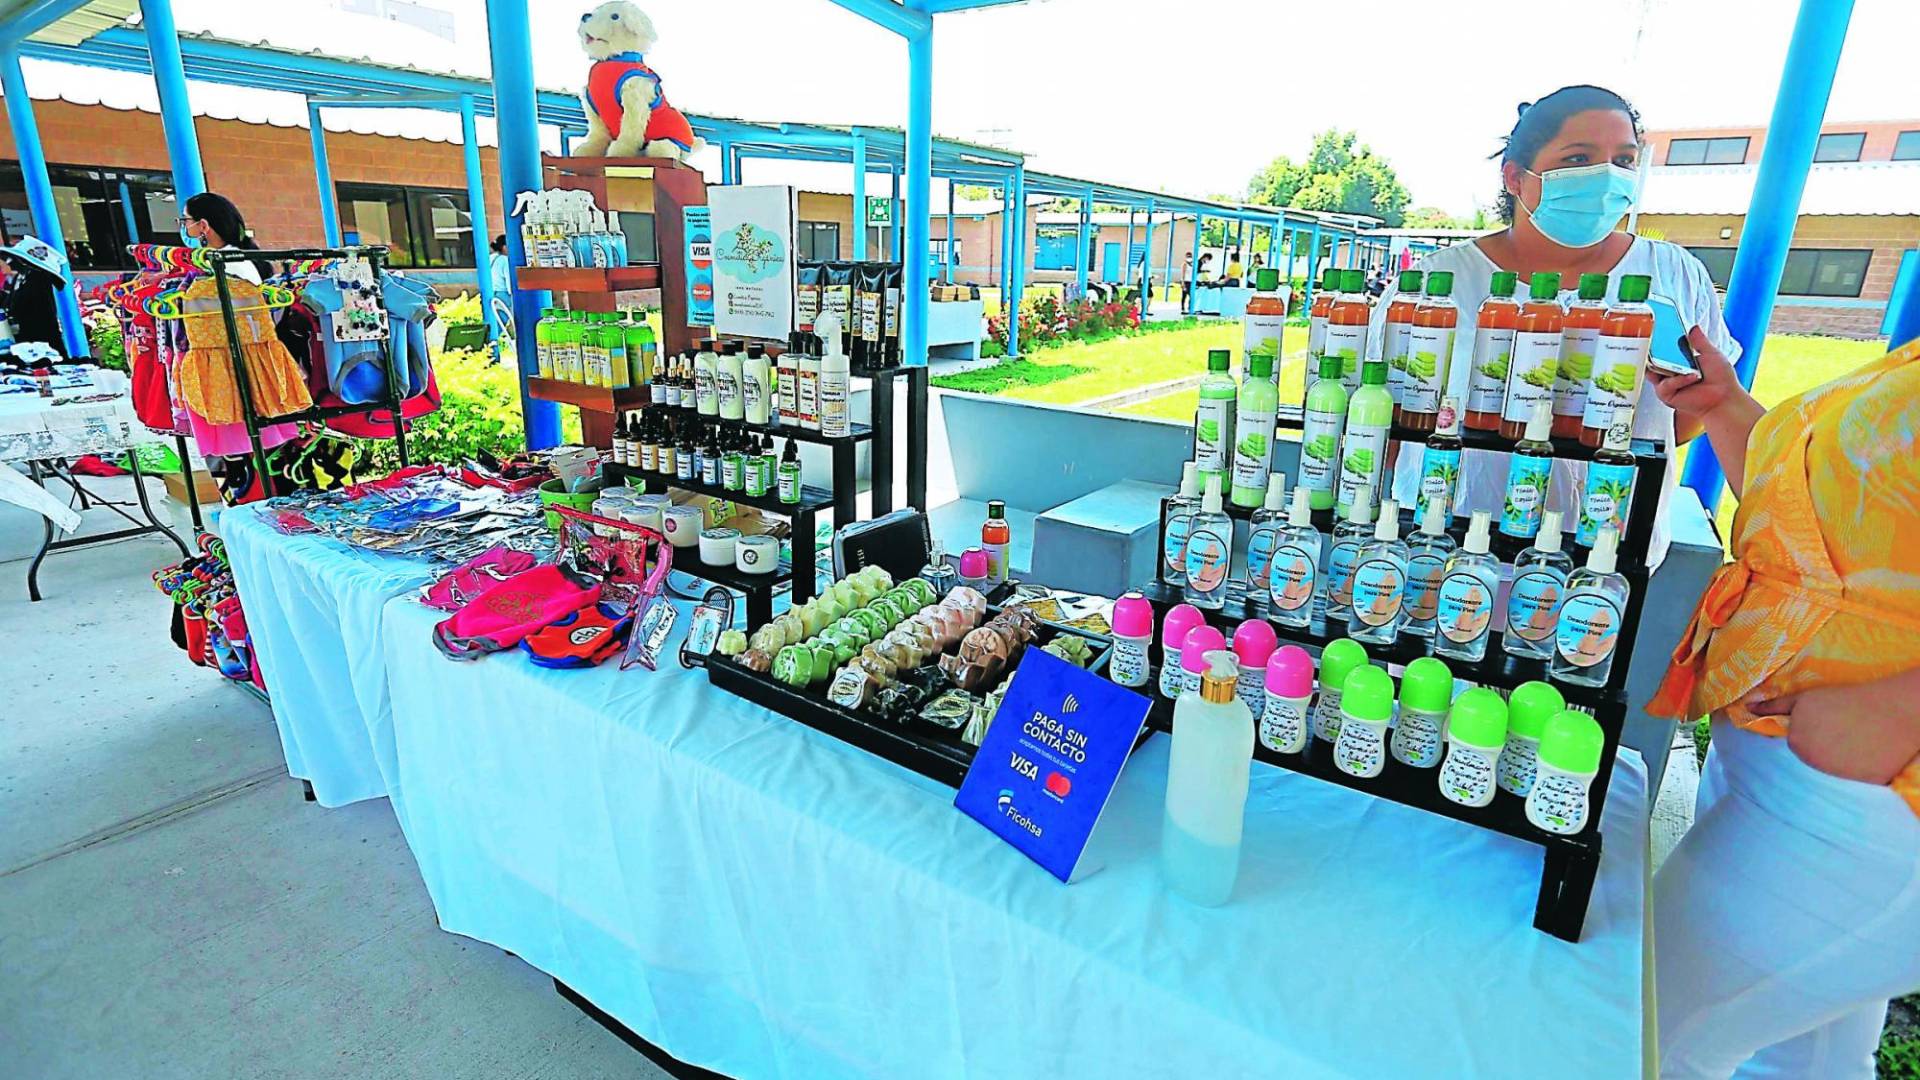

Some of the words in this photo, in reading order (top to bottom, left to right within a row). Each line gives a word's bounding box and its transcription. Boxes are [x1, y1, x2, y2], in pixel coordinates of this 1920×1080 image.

[692, 246, 711, 256] VISA
[1023, 721, 1086, 763] CONTACTO
[1033, 711, 1064, 737] PAGA
[1065, 729, 1088, 748] SIN
[1010, 751, 1039, 781] VISA
[1006, 806, 1043, 837] Ficohsa
